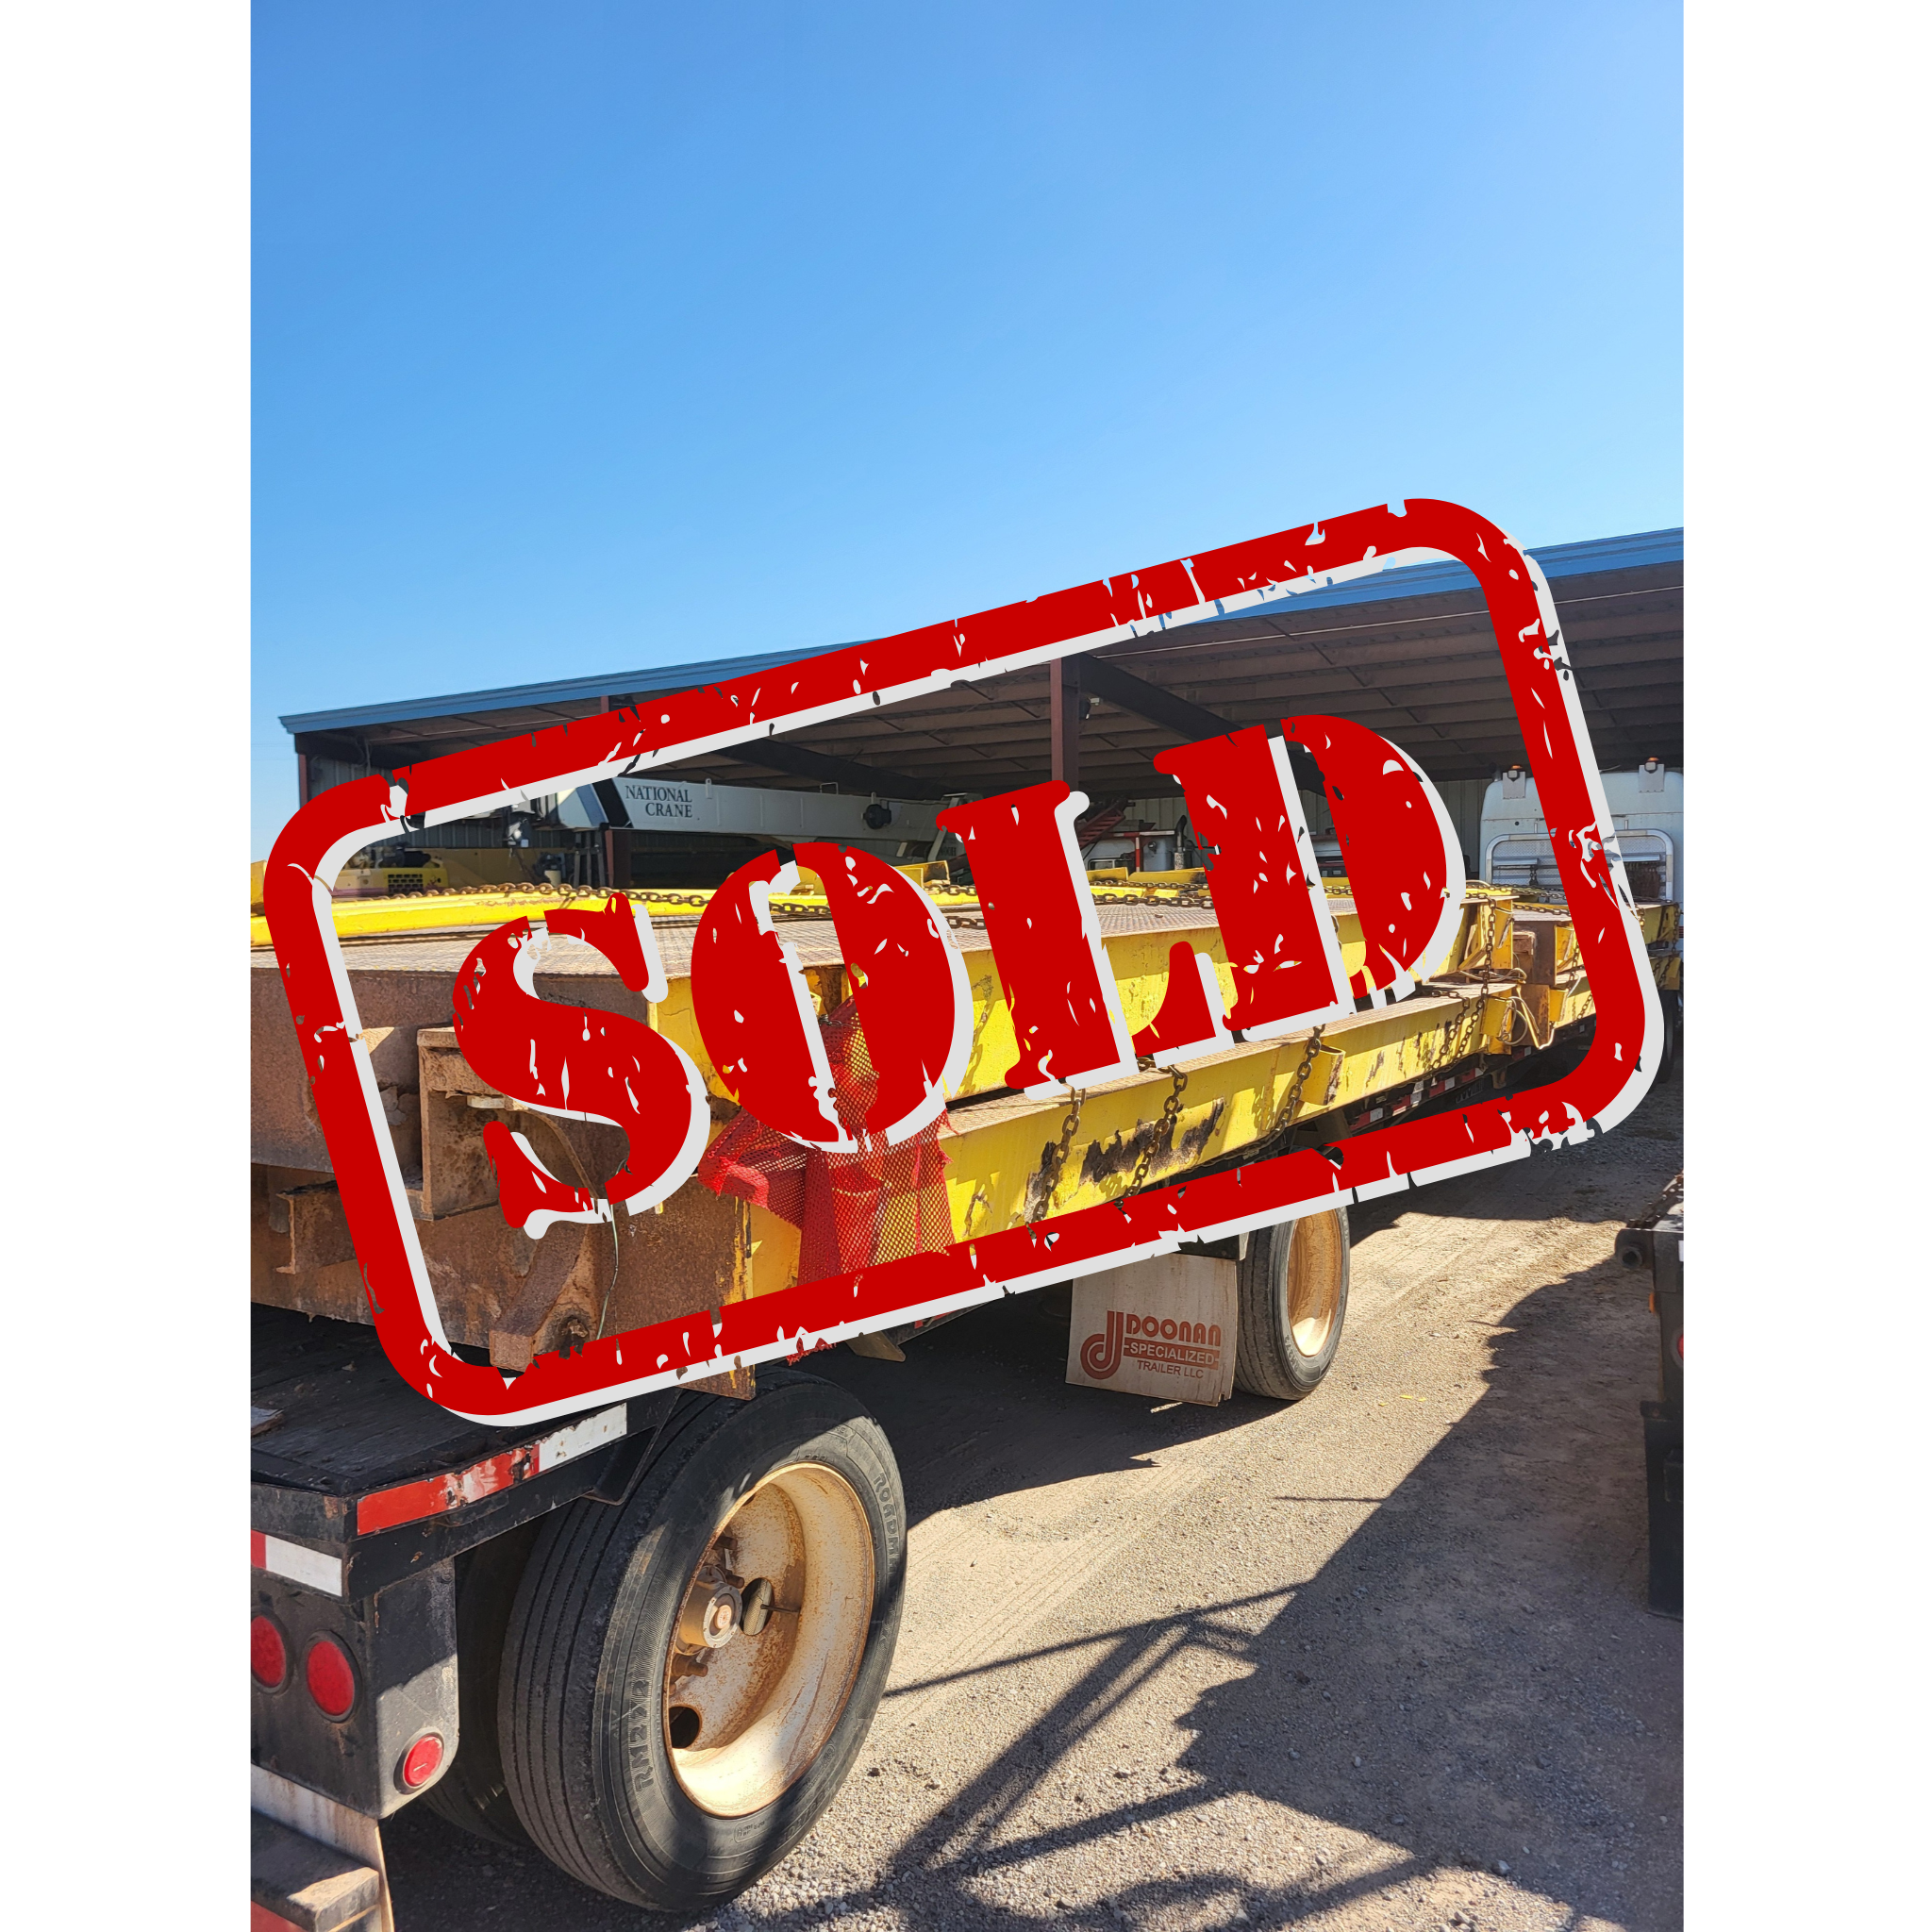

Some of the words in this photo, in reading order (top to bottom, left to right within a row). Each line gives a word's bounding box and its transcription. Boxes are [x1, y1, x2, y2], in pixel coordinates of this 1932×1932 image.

[625, 785, 692, 803] NATIONAL
[645, 802, 693, 818] CRANE
[1125, 1313, 1222, 1347] DOONAN
[1129, 1341, 1215, 1366] SPECIALIZED
[1137, 1359, 1181, 1376] TRAILER
[1184, 1367, 1204, 1379] LLC
